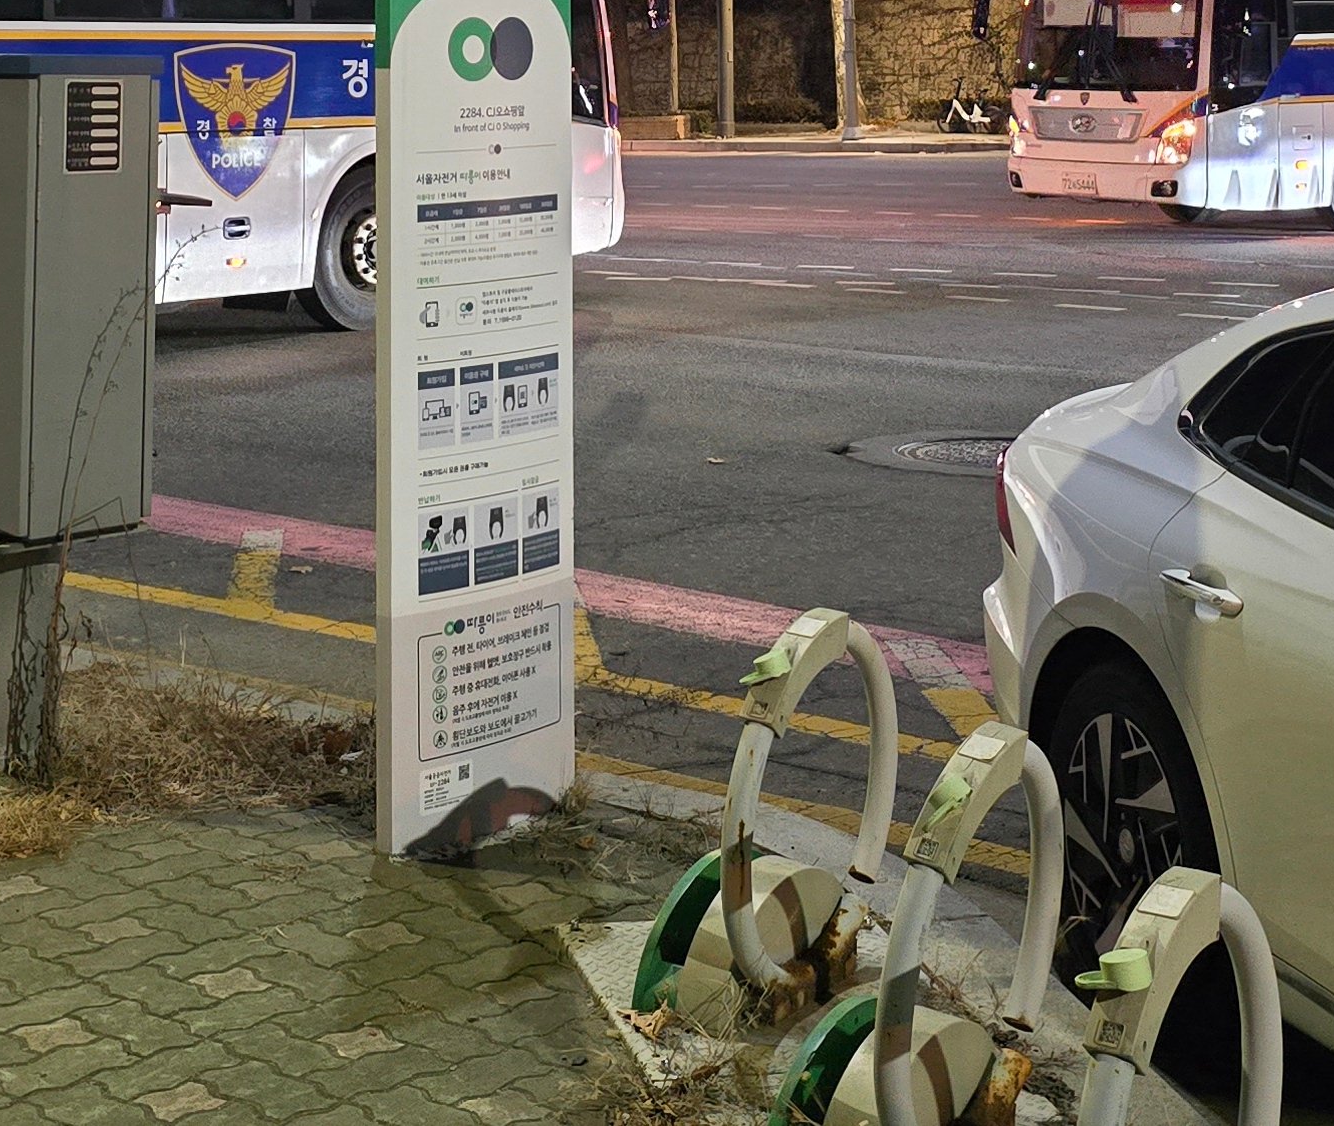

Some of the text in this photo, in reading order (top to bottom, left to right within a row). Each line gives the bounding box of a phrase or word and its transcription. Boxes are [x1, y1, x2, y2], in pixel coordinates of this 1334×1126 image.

[342, 58, 369, 99] 경
[459, 107, 485, 119] 2284.
[196, 119, 211, 140] 경
[453, 124, 461, 133] In
[462, 123, 479, 132] front
[479, 122, 487, 132] of
[502, 121, 530, 132] Shopping
[211, 152, 262, 169] POLICE
[416, 173, 458, 186] 서울자전거
[482, 168, 511, 183] 이용안내
[466, 613, 495, 635] 따릉이
[513, 599, 544, 619] 안전수칙
[480, 694, 500, 710] 자전거
